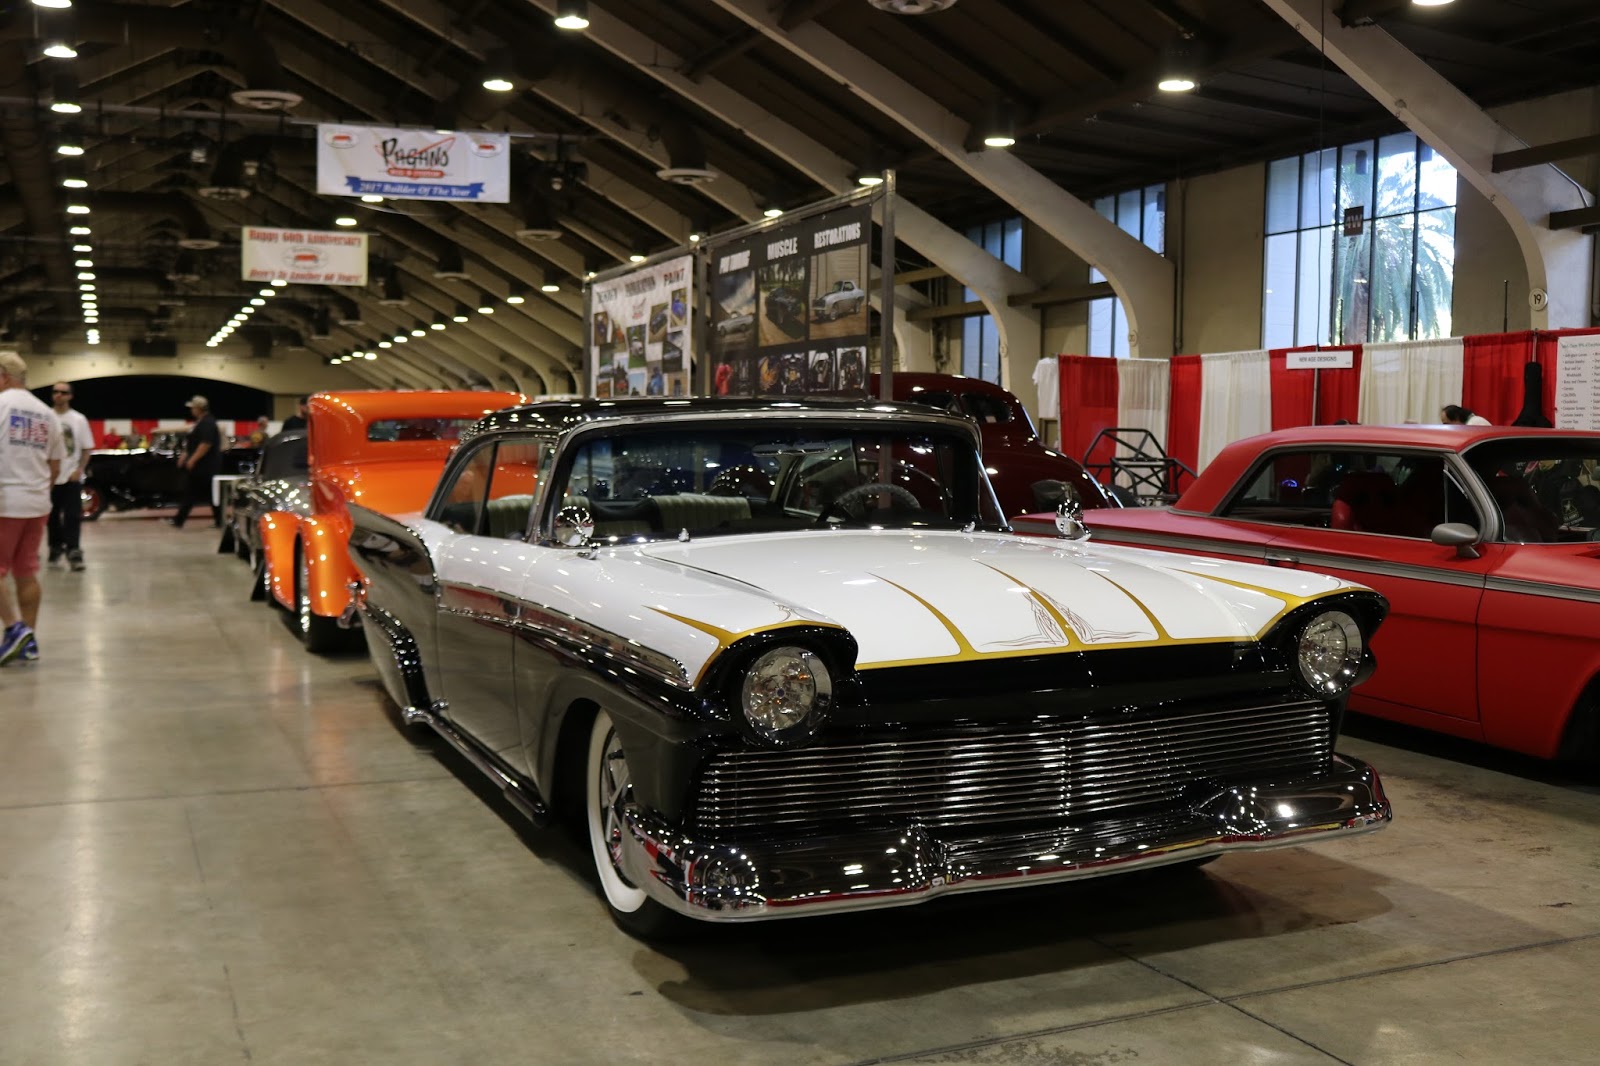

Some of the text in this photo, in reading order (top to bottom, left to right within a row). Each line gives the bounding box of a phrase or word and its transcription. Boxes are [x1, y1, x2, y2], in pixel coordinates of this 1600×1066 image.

[360, 182, 471, 197] 2017 Builder Of The Year
[249, 229, 279, 243] Happy
[814, 221, 861, 249] RESTORATIONS
[767, 237, 798, 261] MUSCLE
[663, 268, 685, 287] PAINT
[1533, 293, 1542, 305] 19
